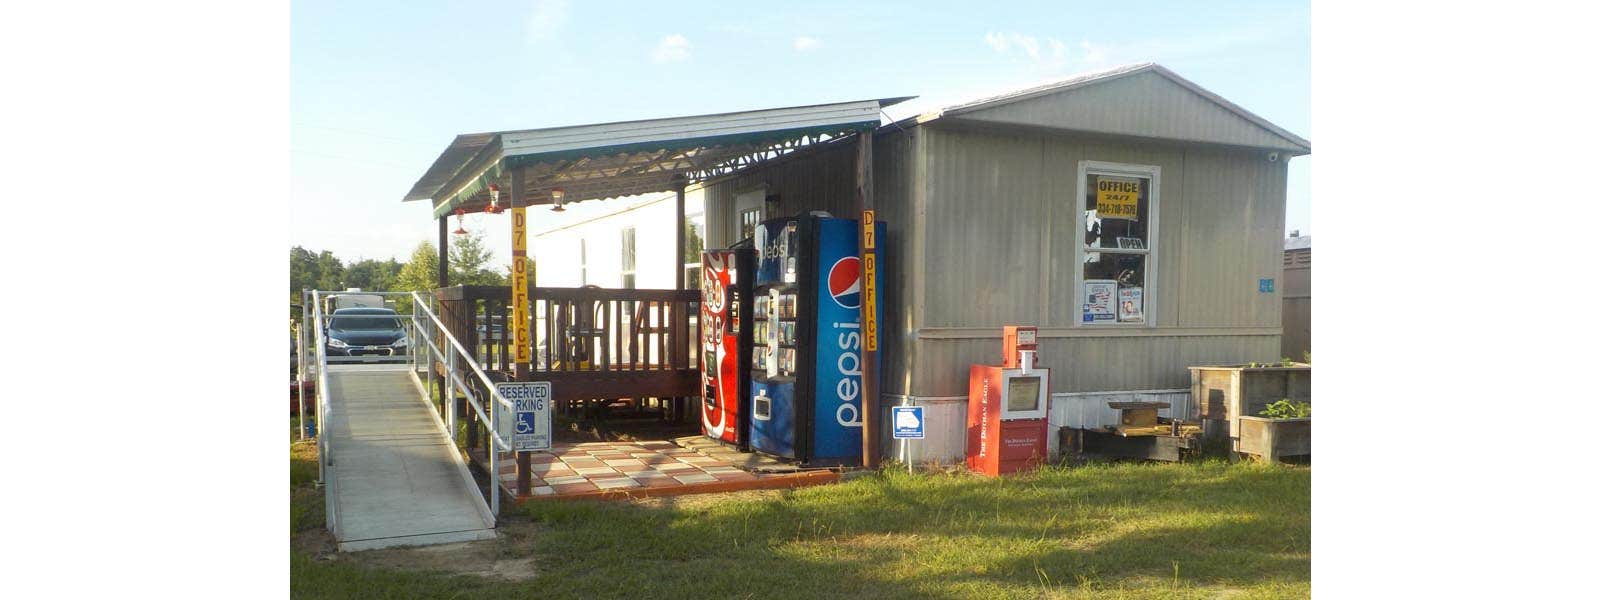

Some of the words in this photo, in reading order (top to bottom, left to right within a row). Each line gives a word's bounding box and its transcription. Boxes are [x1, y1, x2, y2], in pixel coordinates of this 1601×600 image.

[1099, 181, 1137, 192] OFFICE
[1119, 238, 1143, 249] OPEN
[866, 258, 876, 349] OFFICE
[515, 260, 527, 360] OFFICE
[833, 320, 863, 428] pepsi
[500, 386, 547, 398] RESERVED
[509, 399, 544, 411] RKING
